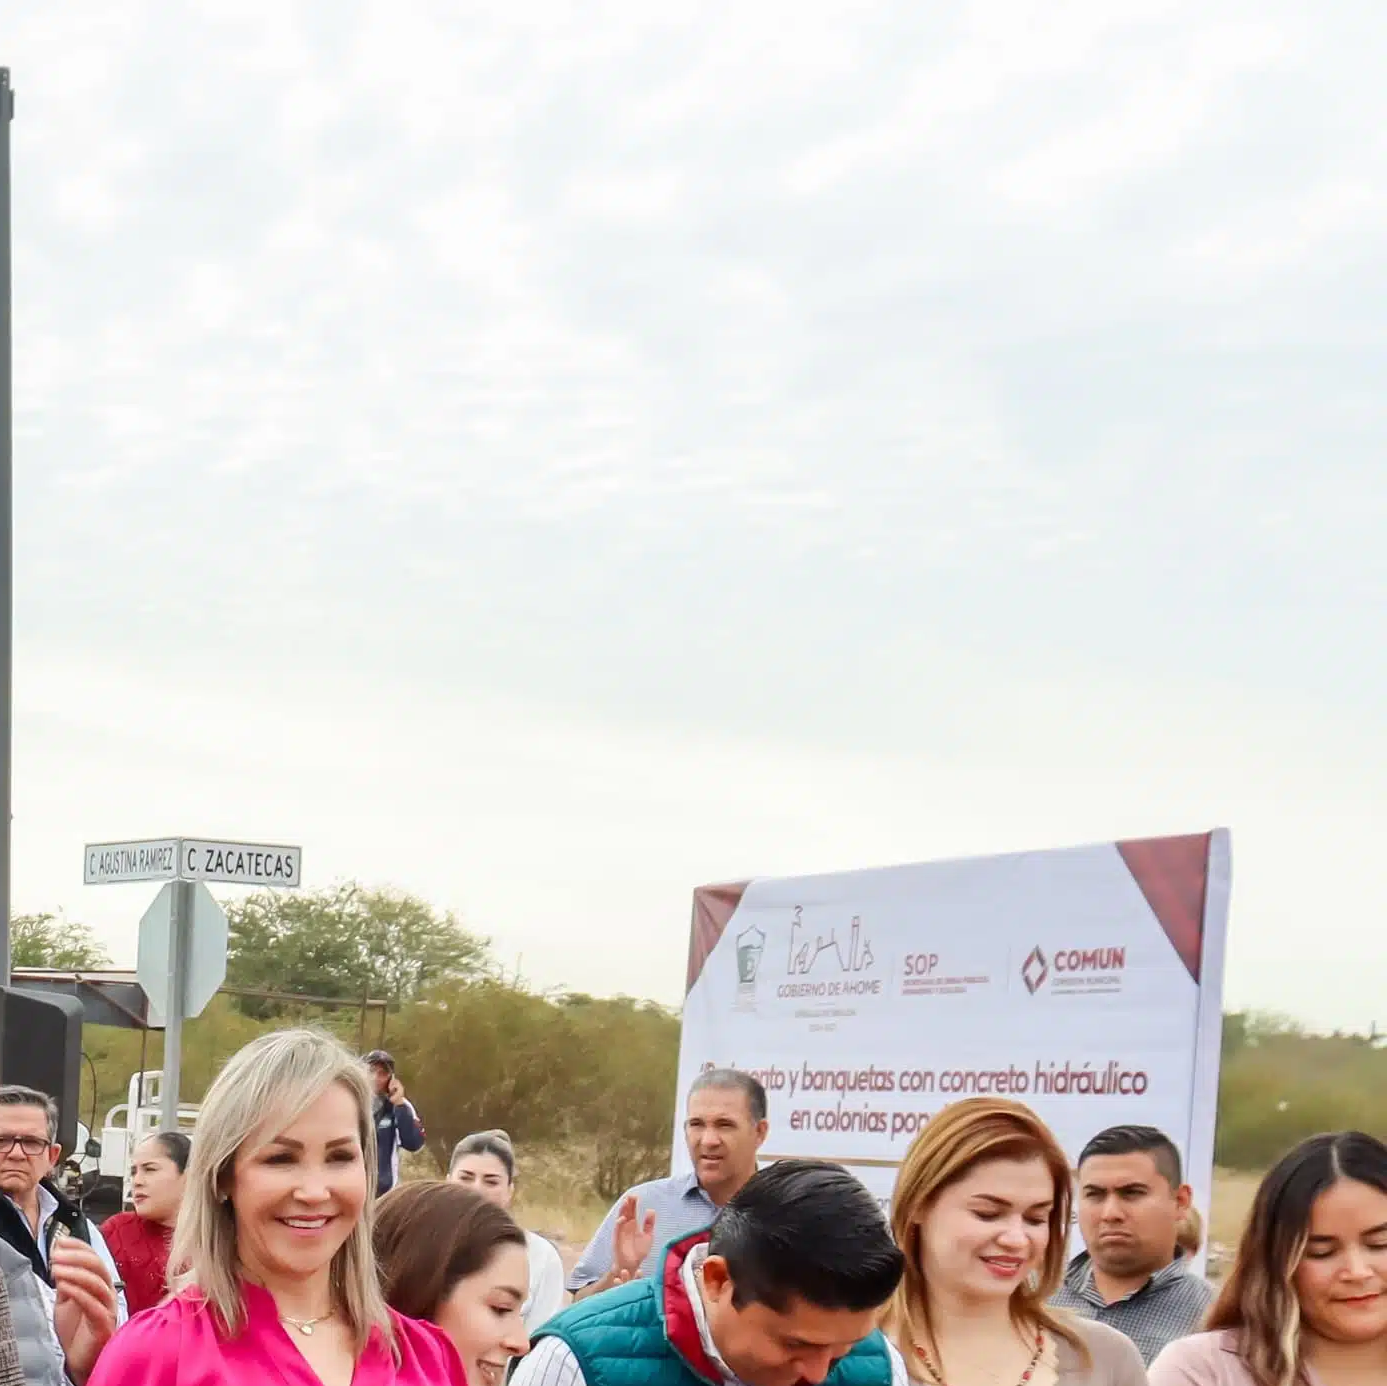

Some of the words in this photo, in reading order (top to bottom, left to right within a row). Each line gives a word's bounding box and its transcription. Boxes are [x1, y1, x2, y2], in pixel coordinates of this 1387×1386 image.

[98, 848, 137, 876] AGUSTINA
[139, 847, 173, 873] RAMIREZ
[205, 849, 293, 878] ZACATECAS
[903, 953, 939, 976] SOP
[1054, 947, 1125, 972] COMUN
[777, 981, 826, 998] GOBIERNO
[828, 981, 841, 996] DE
[842, 979, 882, 996] AHOME
[788, 1068, 800, 1098] y
[801, 1060, 895, 1099] banquetas
[899, 1069, 934, 1092] con
[939, 1063, 1031, 1093] concreto
[1033, 1059, 1149, 1095] hidráulico
[790, 1109, 811, 1130] en
[814, 1102, 888, 1132] colonias
